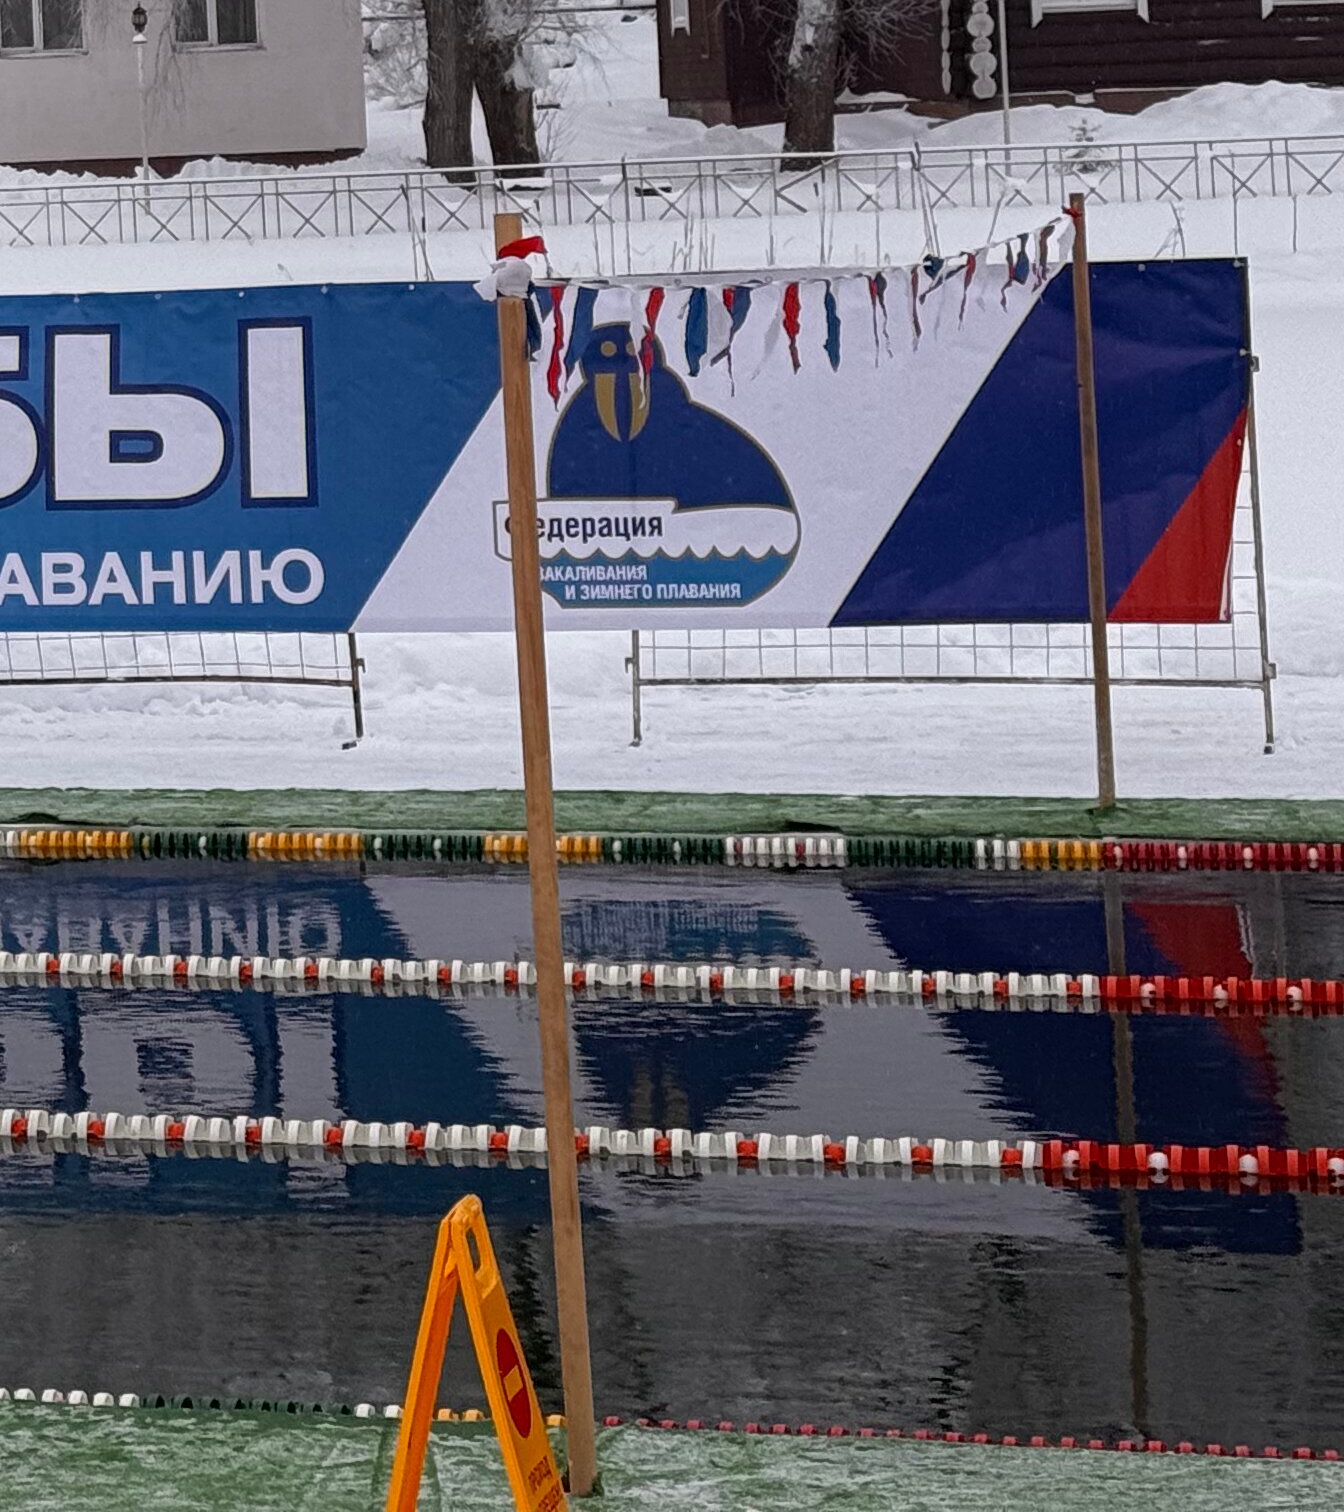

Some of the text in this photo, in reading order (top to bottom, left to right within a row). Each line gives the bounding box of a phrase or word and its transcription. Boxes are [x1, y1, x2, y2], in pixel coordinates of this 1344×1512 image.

[564, 582, 742, 601] И ЗИМНЕГО ПЛАВАНИЯ
